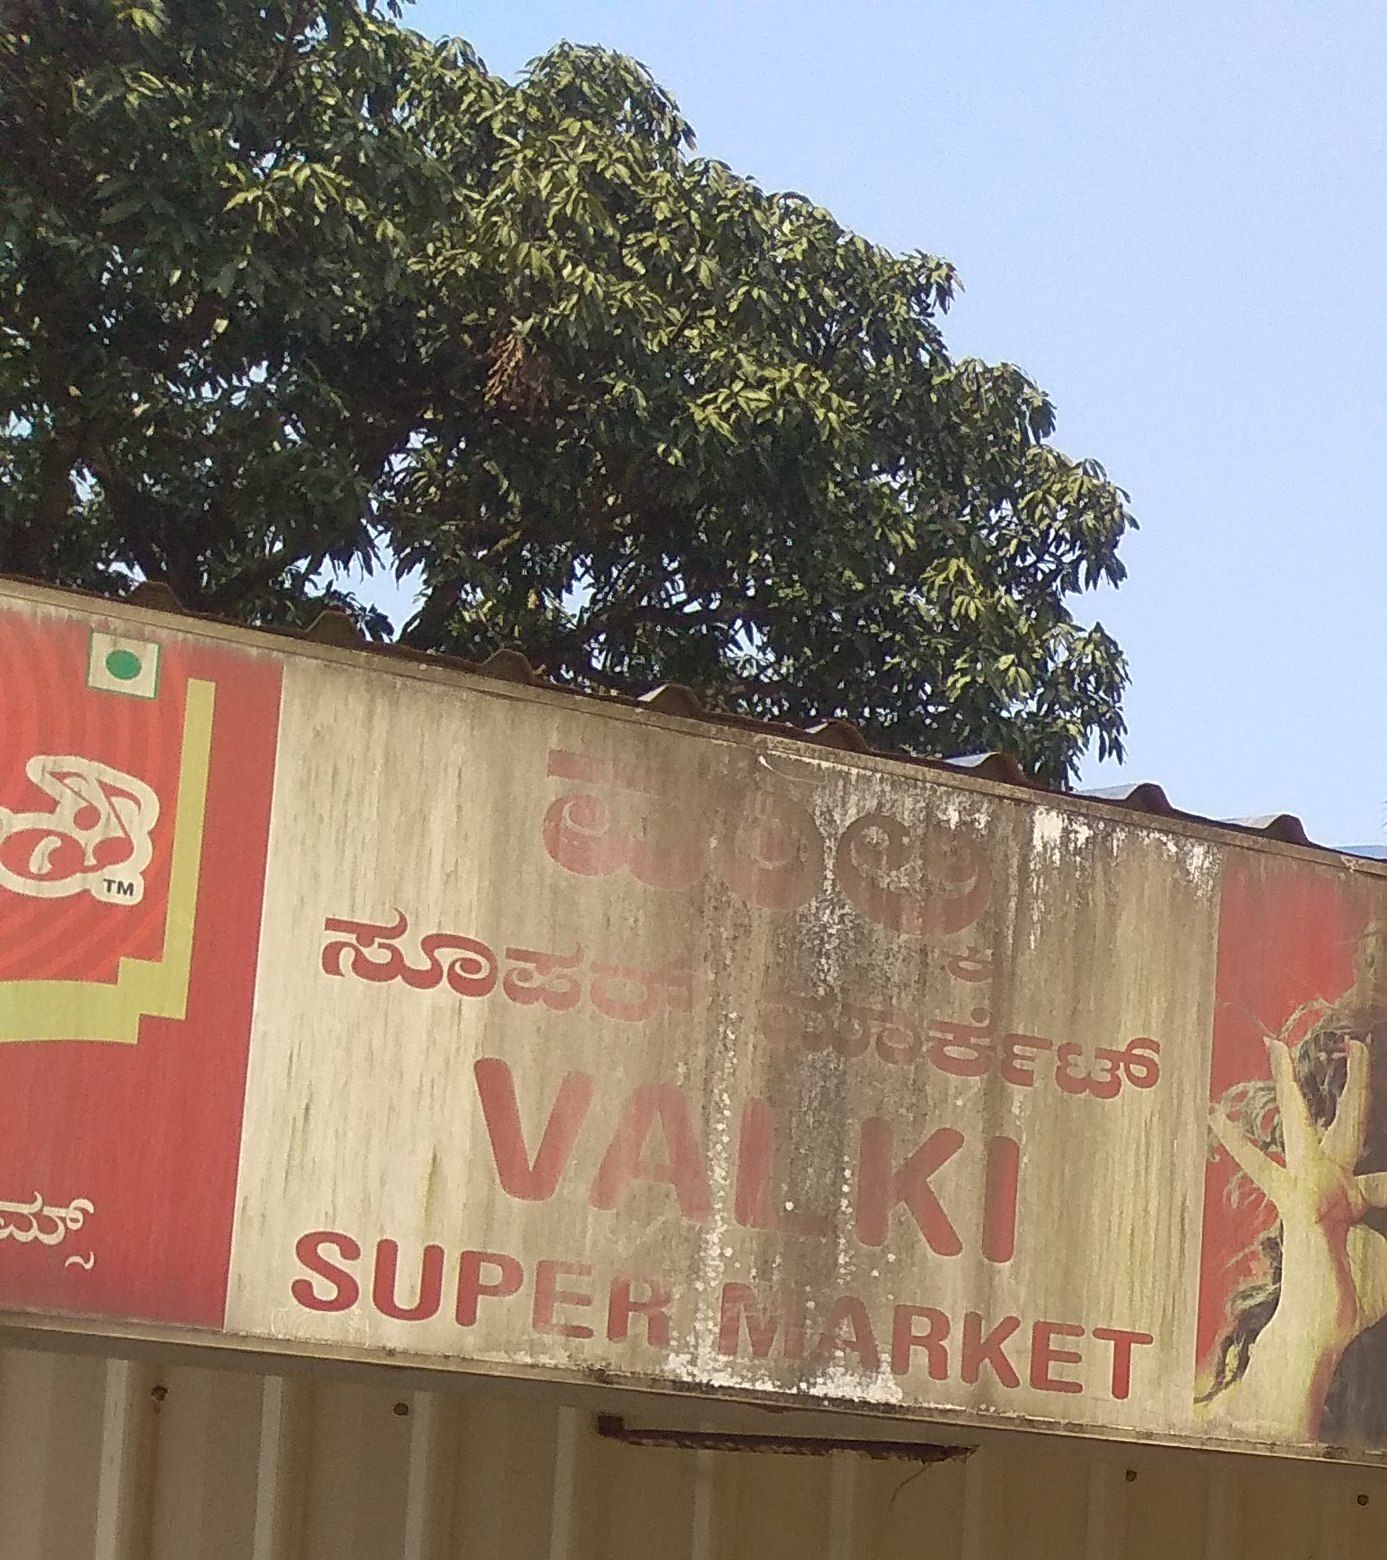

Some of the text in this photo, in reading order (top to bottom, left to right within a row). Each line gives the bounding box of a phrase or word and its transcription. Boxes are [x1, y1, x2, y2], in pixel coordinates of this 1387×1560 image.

[103, 878, 135, 897] TM
[473, 1057, 1020, 1264] VALKI
[290, 1230, 1154, 1400] SUPER MARKET
